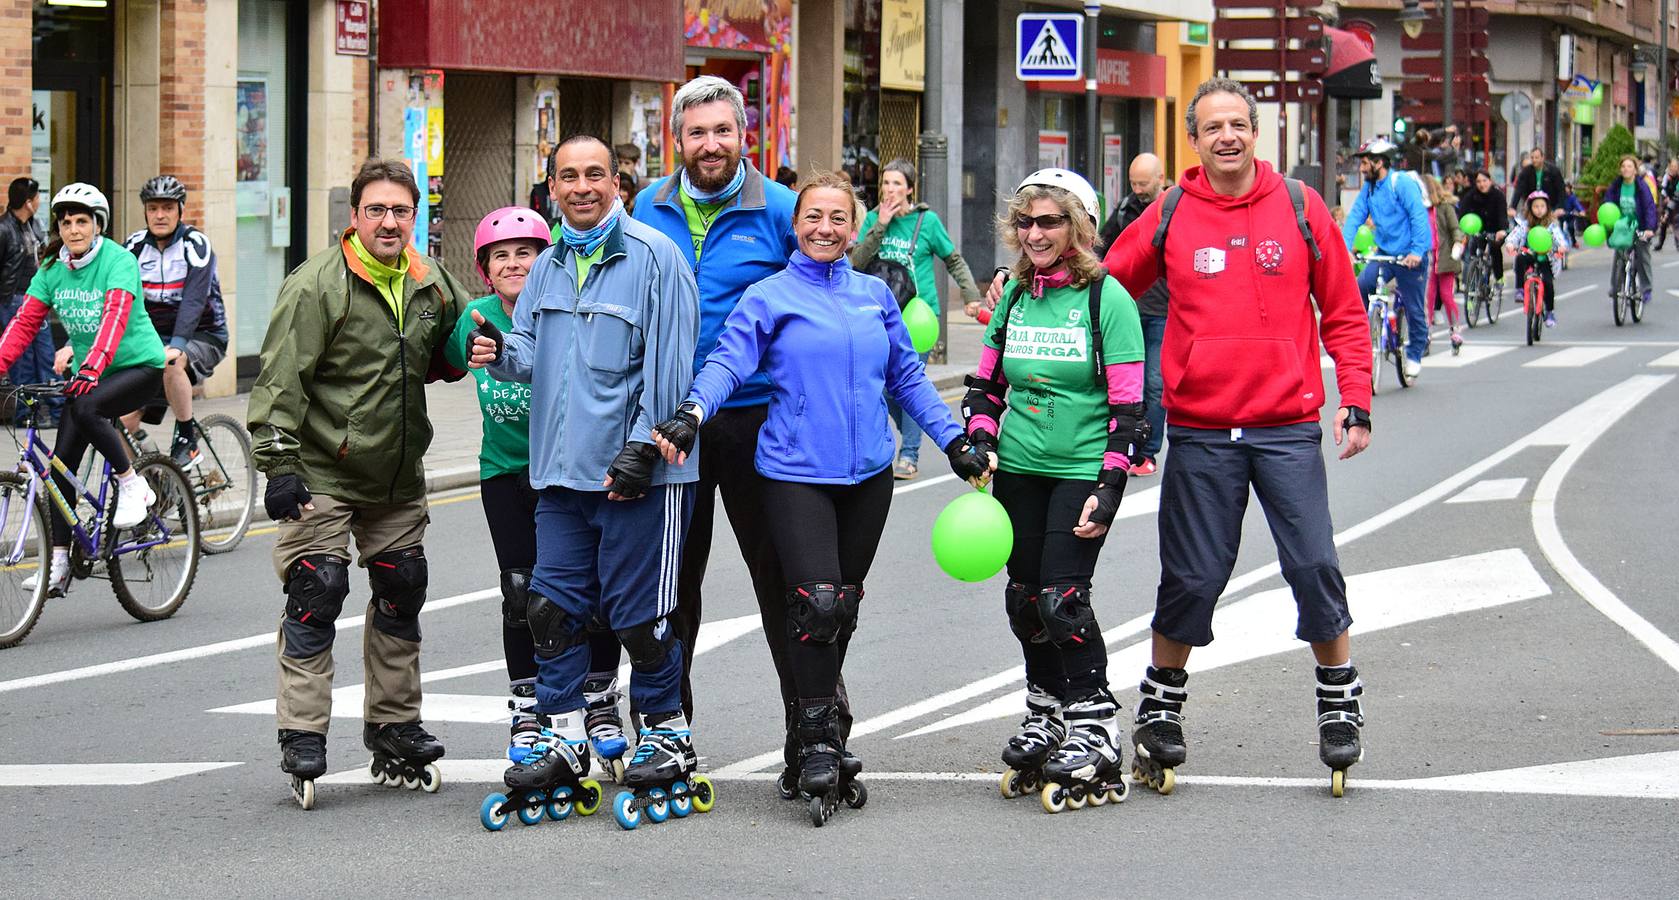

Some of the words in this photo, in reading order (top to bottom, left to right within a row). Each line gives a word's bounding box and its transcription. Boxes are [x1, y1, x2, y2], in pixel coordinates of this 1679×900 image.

[1033, 331, 1077, 344] RURAL
[1004, 343, 1034, 355] GUROS
[1036, 346, 1082, 357] RGA
[492, 389, 509, 399] DE
[515, 388, 532, 398] TO
